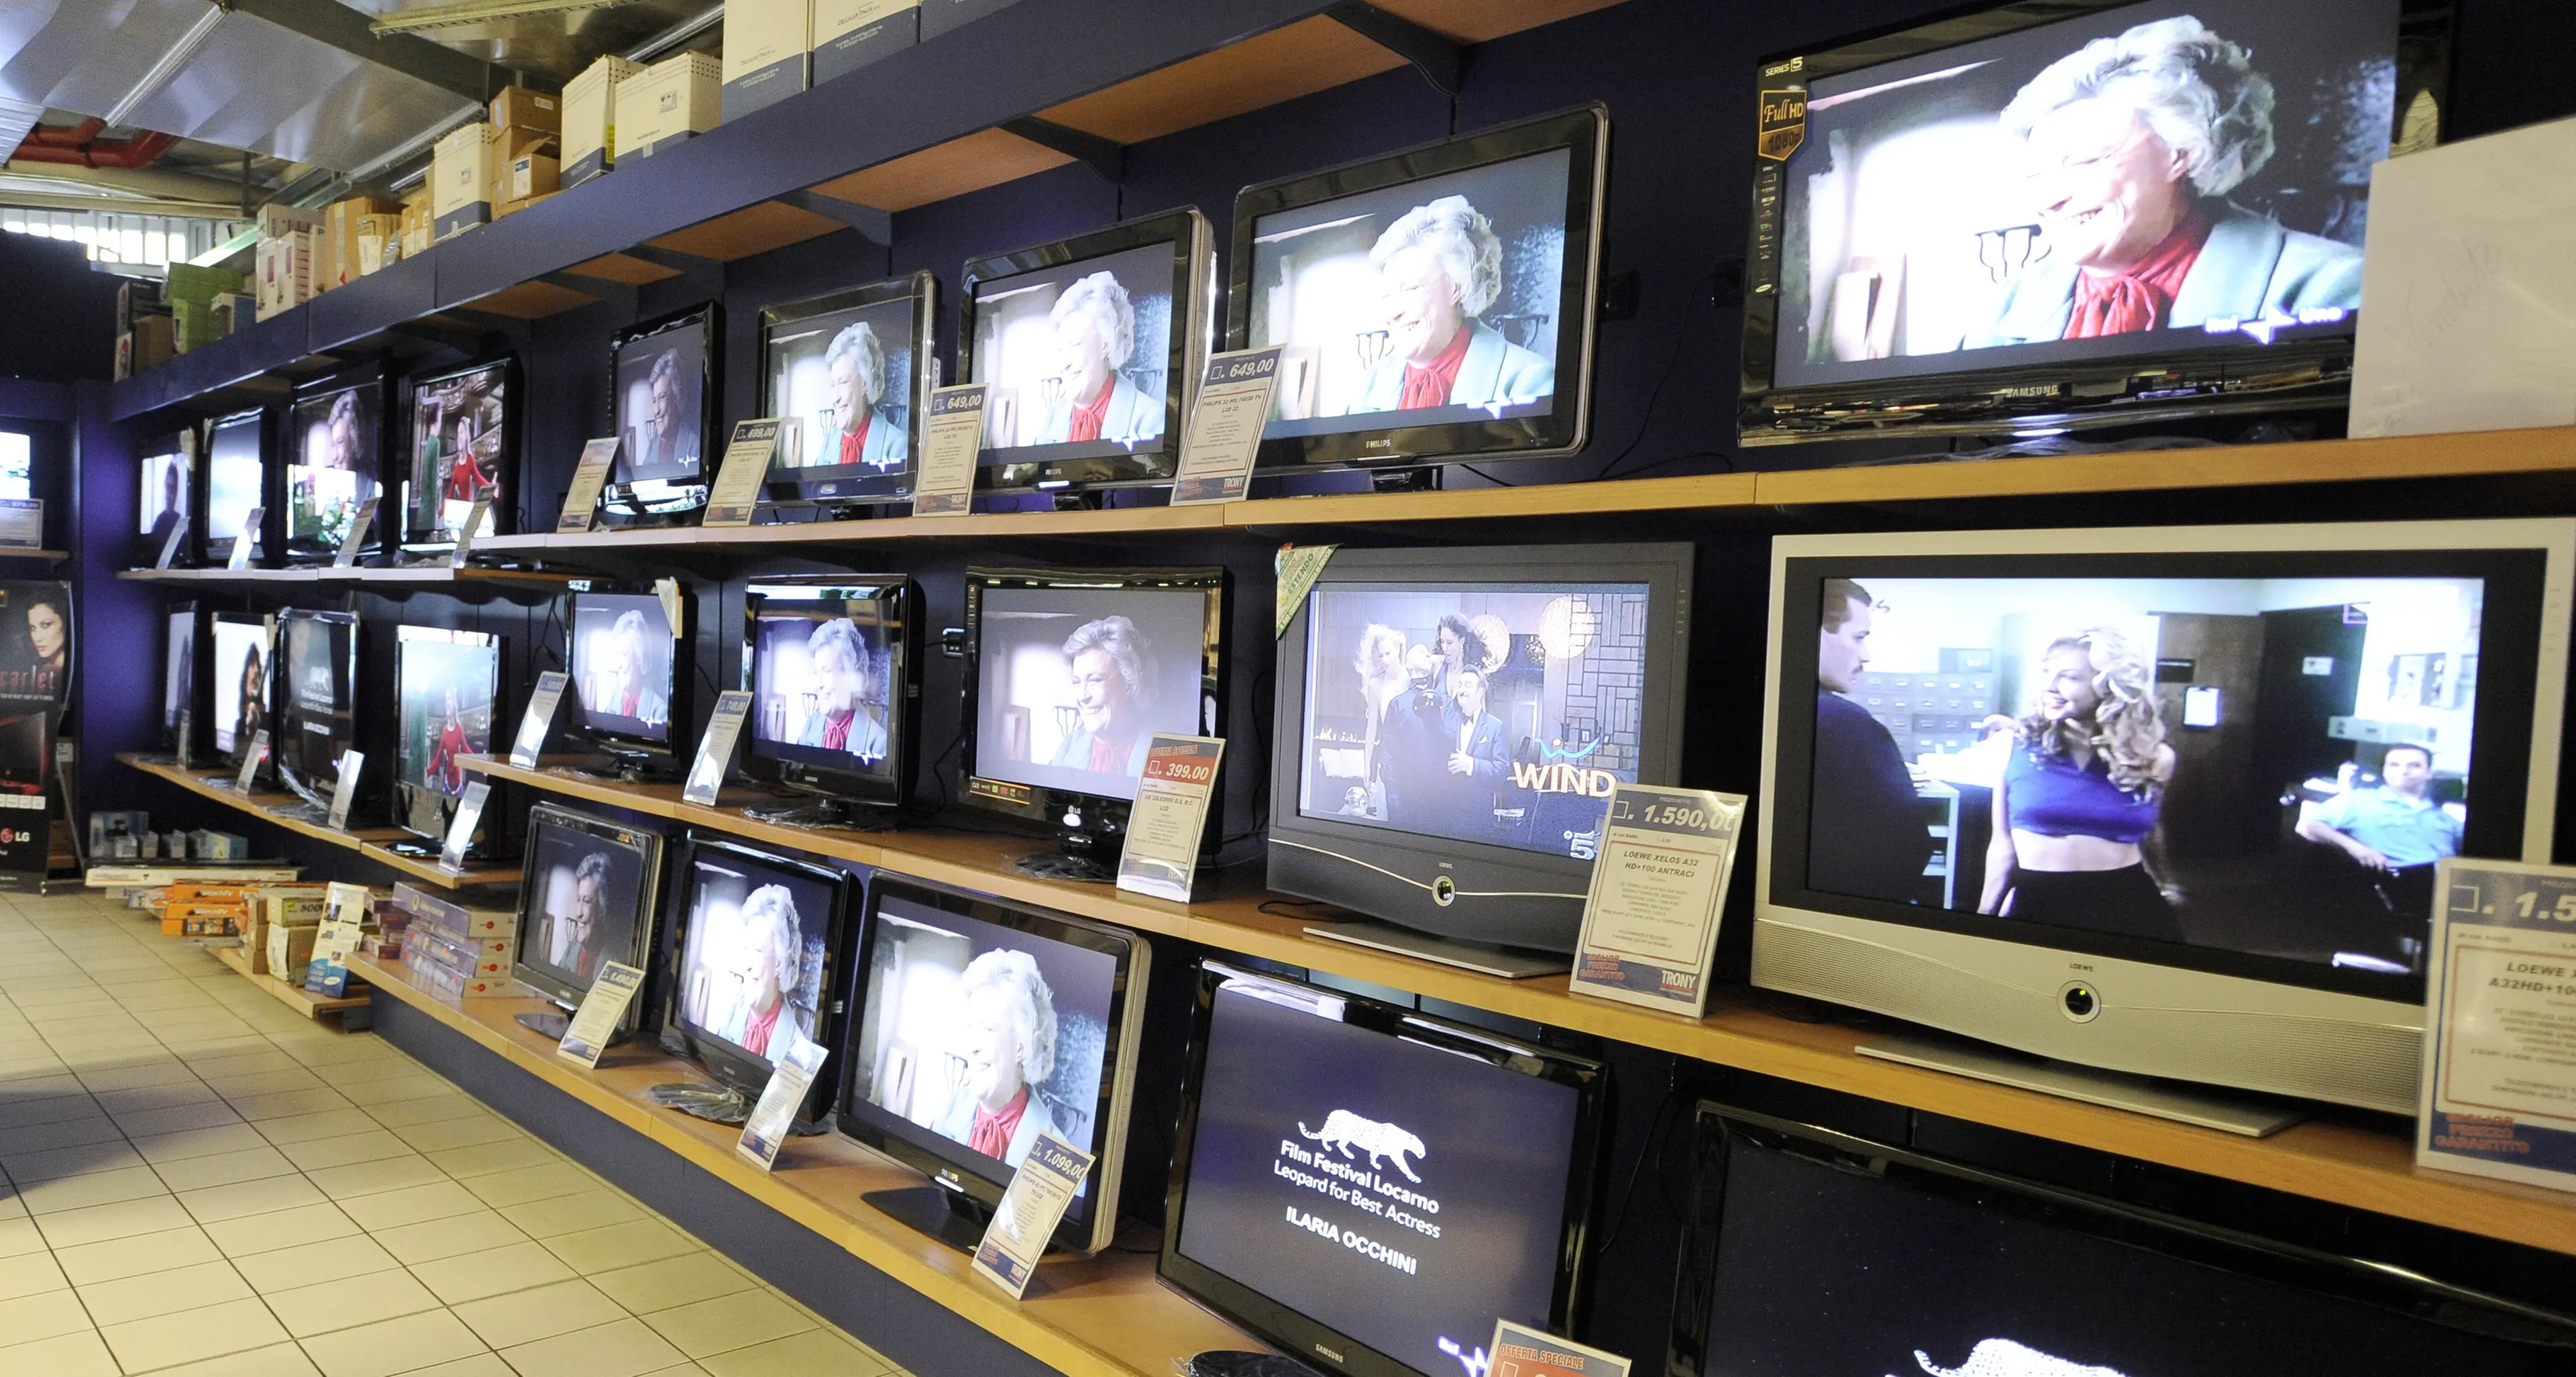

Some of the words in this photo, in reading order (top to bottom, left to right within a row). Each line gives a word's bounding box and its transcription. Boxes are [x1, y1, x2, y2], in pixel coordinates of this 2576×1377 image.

[1766, 64, 1789, 76] SERIES
[1790, 56, 1803, 71] 5
[1764, 99, 1790, 123] Full
[1789, 103, 1803, 119] HD
[1230, 358, 1275, 378] 649,00
[2006, 385, 2058, 398] SAMSUNG
[947, 394, 982, 410] 649,00
[1366, 439, 1391, 449] PHILIPS
[1287, 553, 1314, 595] ESTENDO
[1513, 761, 1617, 797] WIND
[15, 832, 30, 842] LG
[1624, 850, 1652, 861] LOEWE
[1654, 855, 1680, 865] XELOS
[1682, 859, 1699, 867] A32
[1625, 863, 1655, 873] HD+100
[1657, 867, 1695, 878] ANTRACI
[1662, 970, 1697, 989] TRONY
[2507, 962, 2565, 977] LOEWE
[1281, 1140, 1311, 1165] Film
[1313, 1152, 1371, 1189] Festival
[1374, 1175, 1439, 1214] Locarno
[1274, 1160, 1328, 1193] Leopard
[1329, 1182, 1350, 1201] for
[1351, 1189, 1383, 1215] Best
[1385, 1205, 1440, 1239] Actress
[1286, 1207, 1340, 1243] ILARIA
[1342, 1231, 1417, 1275] OCCHINI
[1316, 1343, 1343, 1363] SAMSUNG
[1501, 1343, 1538, 1362] OFFERTA
[1540, 1350, 1584, 1370] SPECIALE
